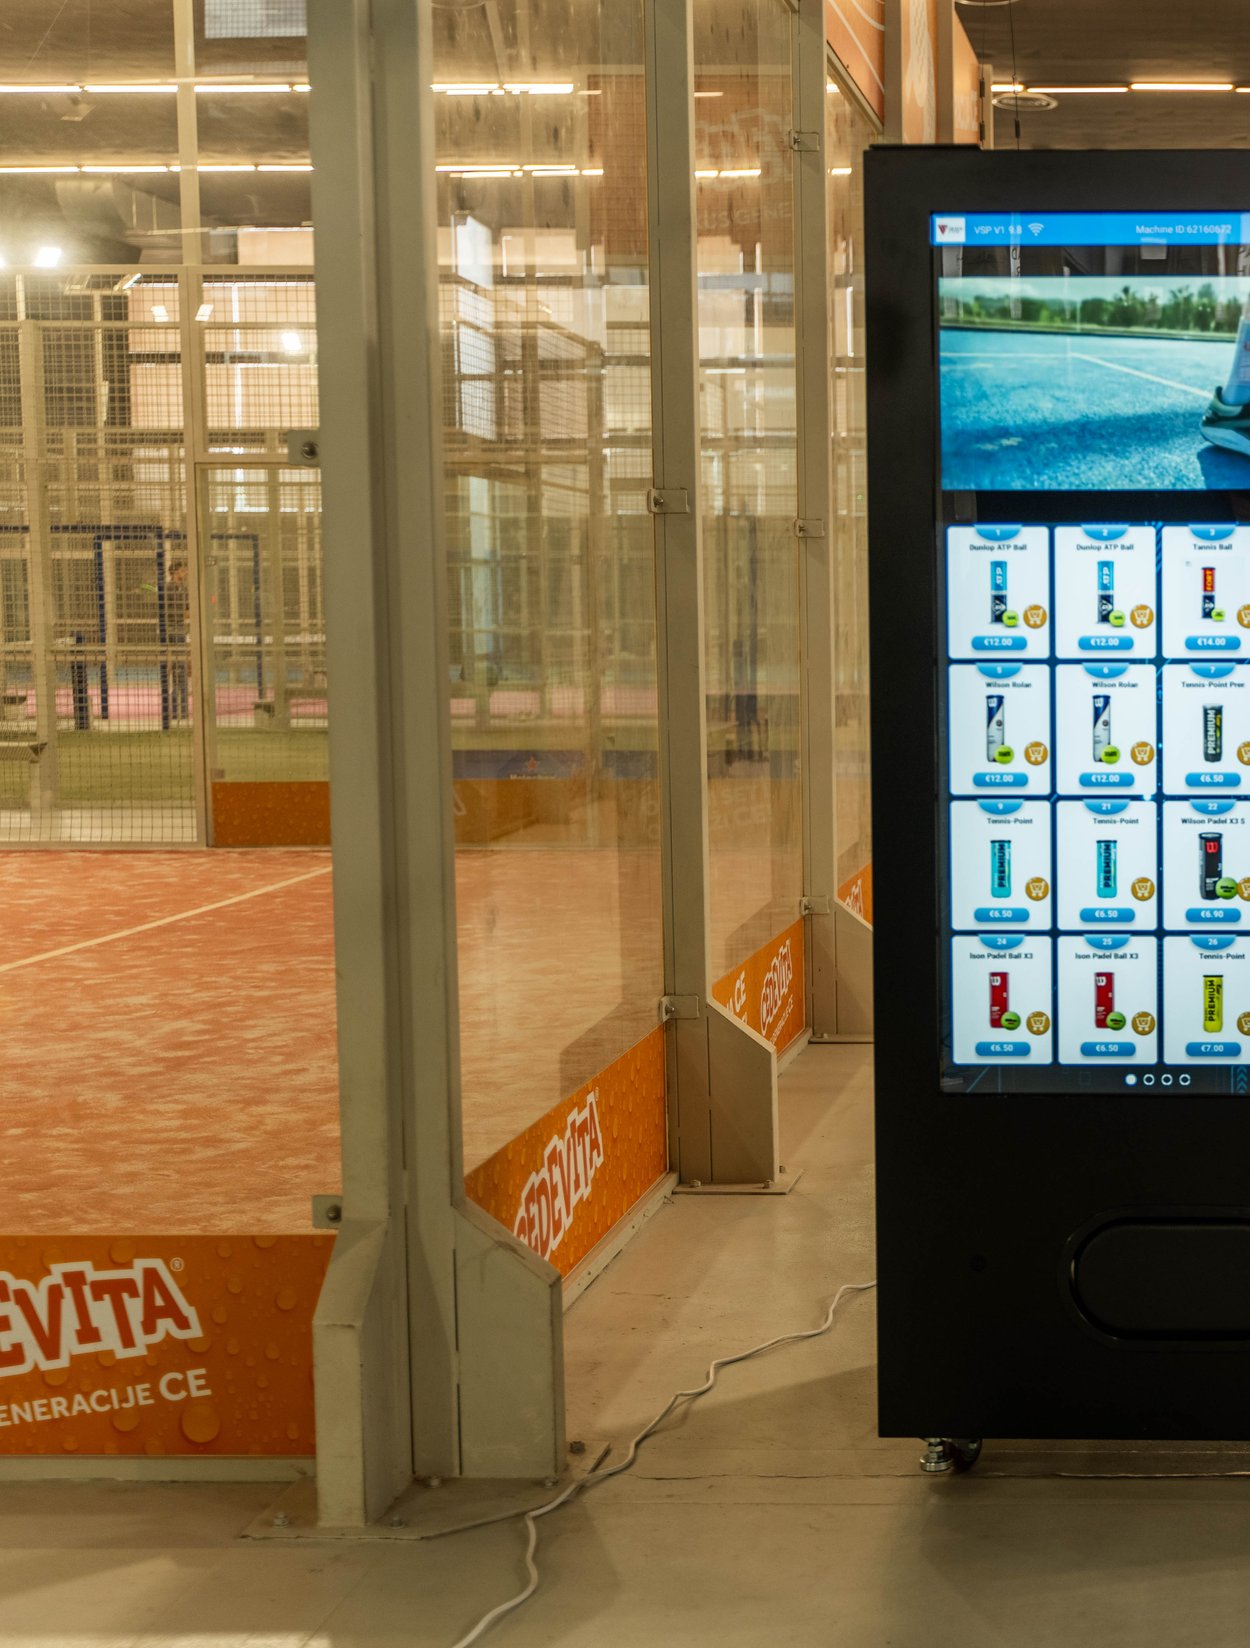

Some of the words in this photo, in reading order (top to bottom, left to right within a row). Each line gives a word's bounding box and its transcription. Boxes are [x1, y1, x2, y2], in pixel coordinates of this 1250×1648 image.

[974, 225, 992, 235] VSP
[1136, 224, 1172, 234] Machine
[1175, 225, 1184, 234] ID
[984, 638, 1012, 646] €12.00
[1090, 638, 1119, 646] €12.00
[1197, 638, 1226, 646] €14.00
[1207, 709, 1215, 754] PREMIUM
[985, 775, 1014, 783] €12.00
[1091, 775, 1119, 783] €12.00
[1200, 775, 1224, 783] €6.50
[989, 910, 1012, 918] €6.50
[1095, 910, 1118, 918] €6.50
[1200, 910, 1224, 918] €6.90
[991, 1044, 1013, 1052] €6.50
[1096, 1044, 1118, 1052] €6.50
[1201, 1044, 1224, 1052] €7.00
[159, 1368, 212, 1401] CE
